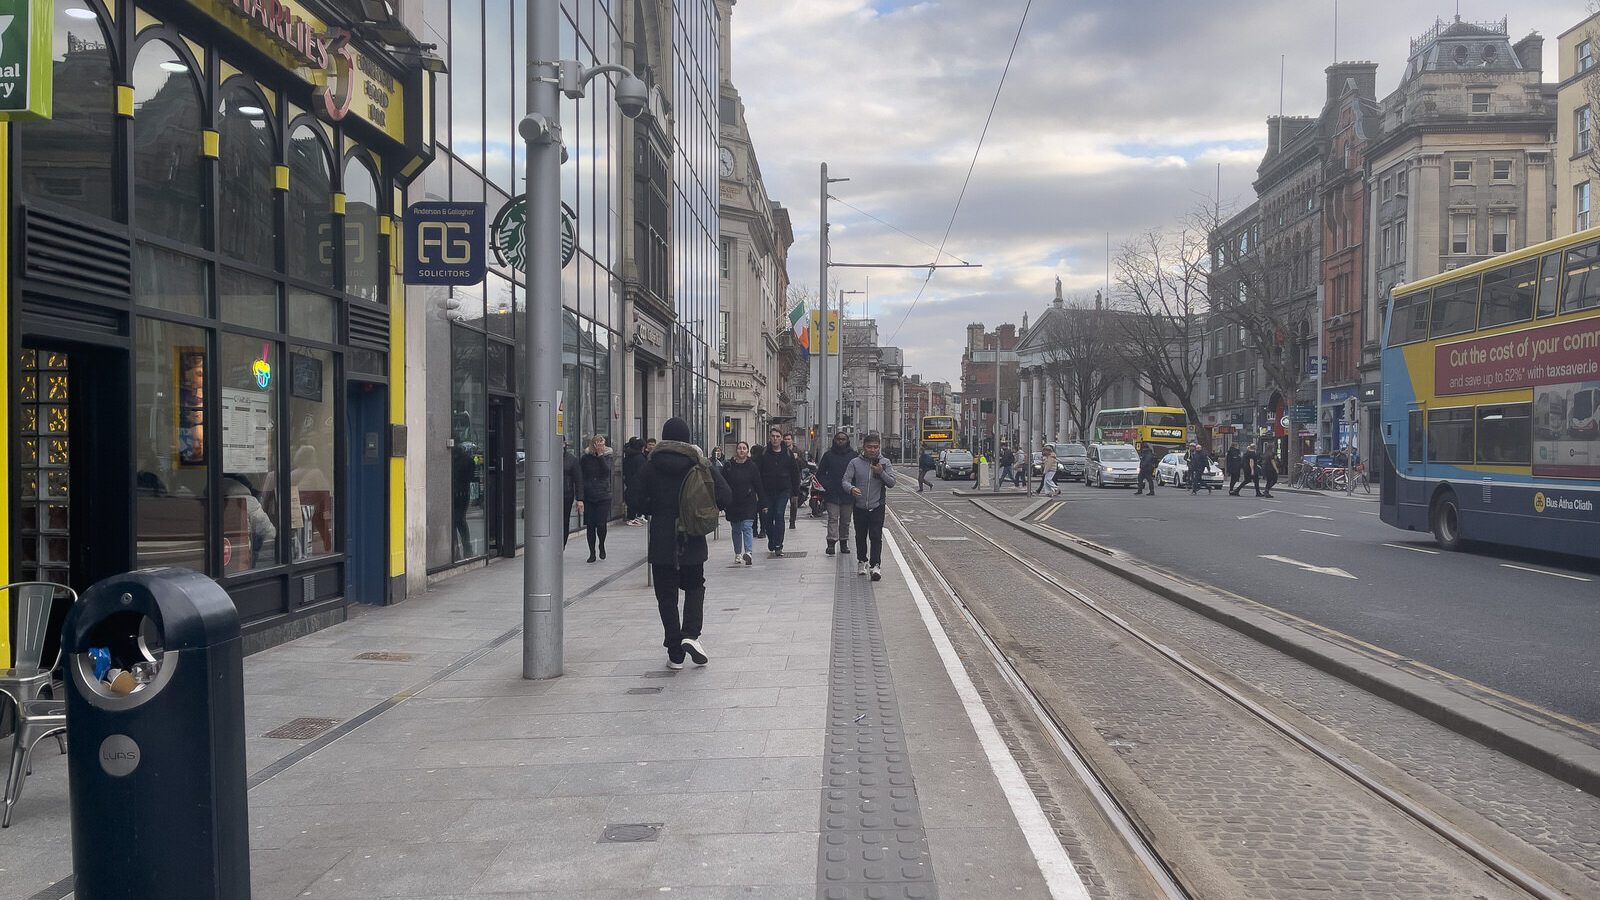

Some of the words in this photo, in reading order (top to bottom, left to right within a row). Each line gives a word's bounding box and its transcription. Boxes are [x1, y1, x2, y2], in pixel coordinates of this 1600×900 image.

[418, 222, 471, 264] AG
[418, 269, 471, 278] SOLICITORS
[814, 320, 836, 332] YS
[1450, 349, 1468, 367] Cut
[1470, 344, 1487, 364] the
[1489, 341, 1515, 362] cost
[1516, 336, 1529, 358] of
[1531, 336, 1560, 362] your
[1449, 375, 1464, 389] and
[1464, 375, 1482, 386] save
[1483, 373, 1494, 388] up
[1495, 371, 1504, 383] to
[1527, 365, 1545, 380] with
[1546, 358, 1598, 378] taxsaver.ie
[1546, 497, 1558, 508] Bus
[1573, 499, 1593, 511] Cliath
